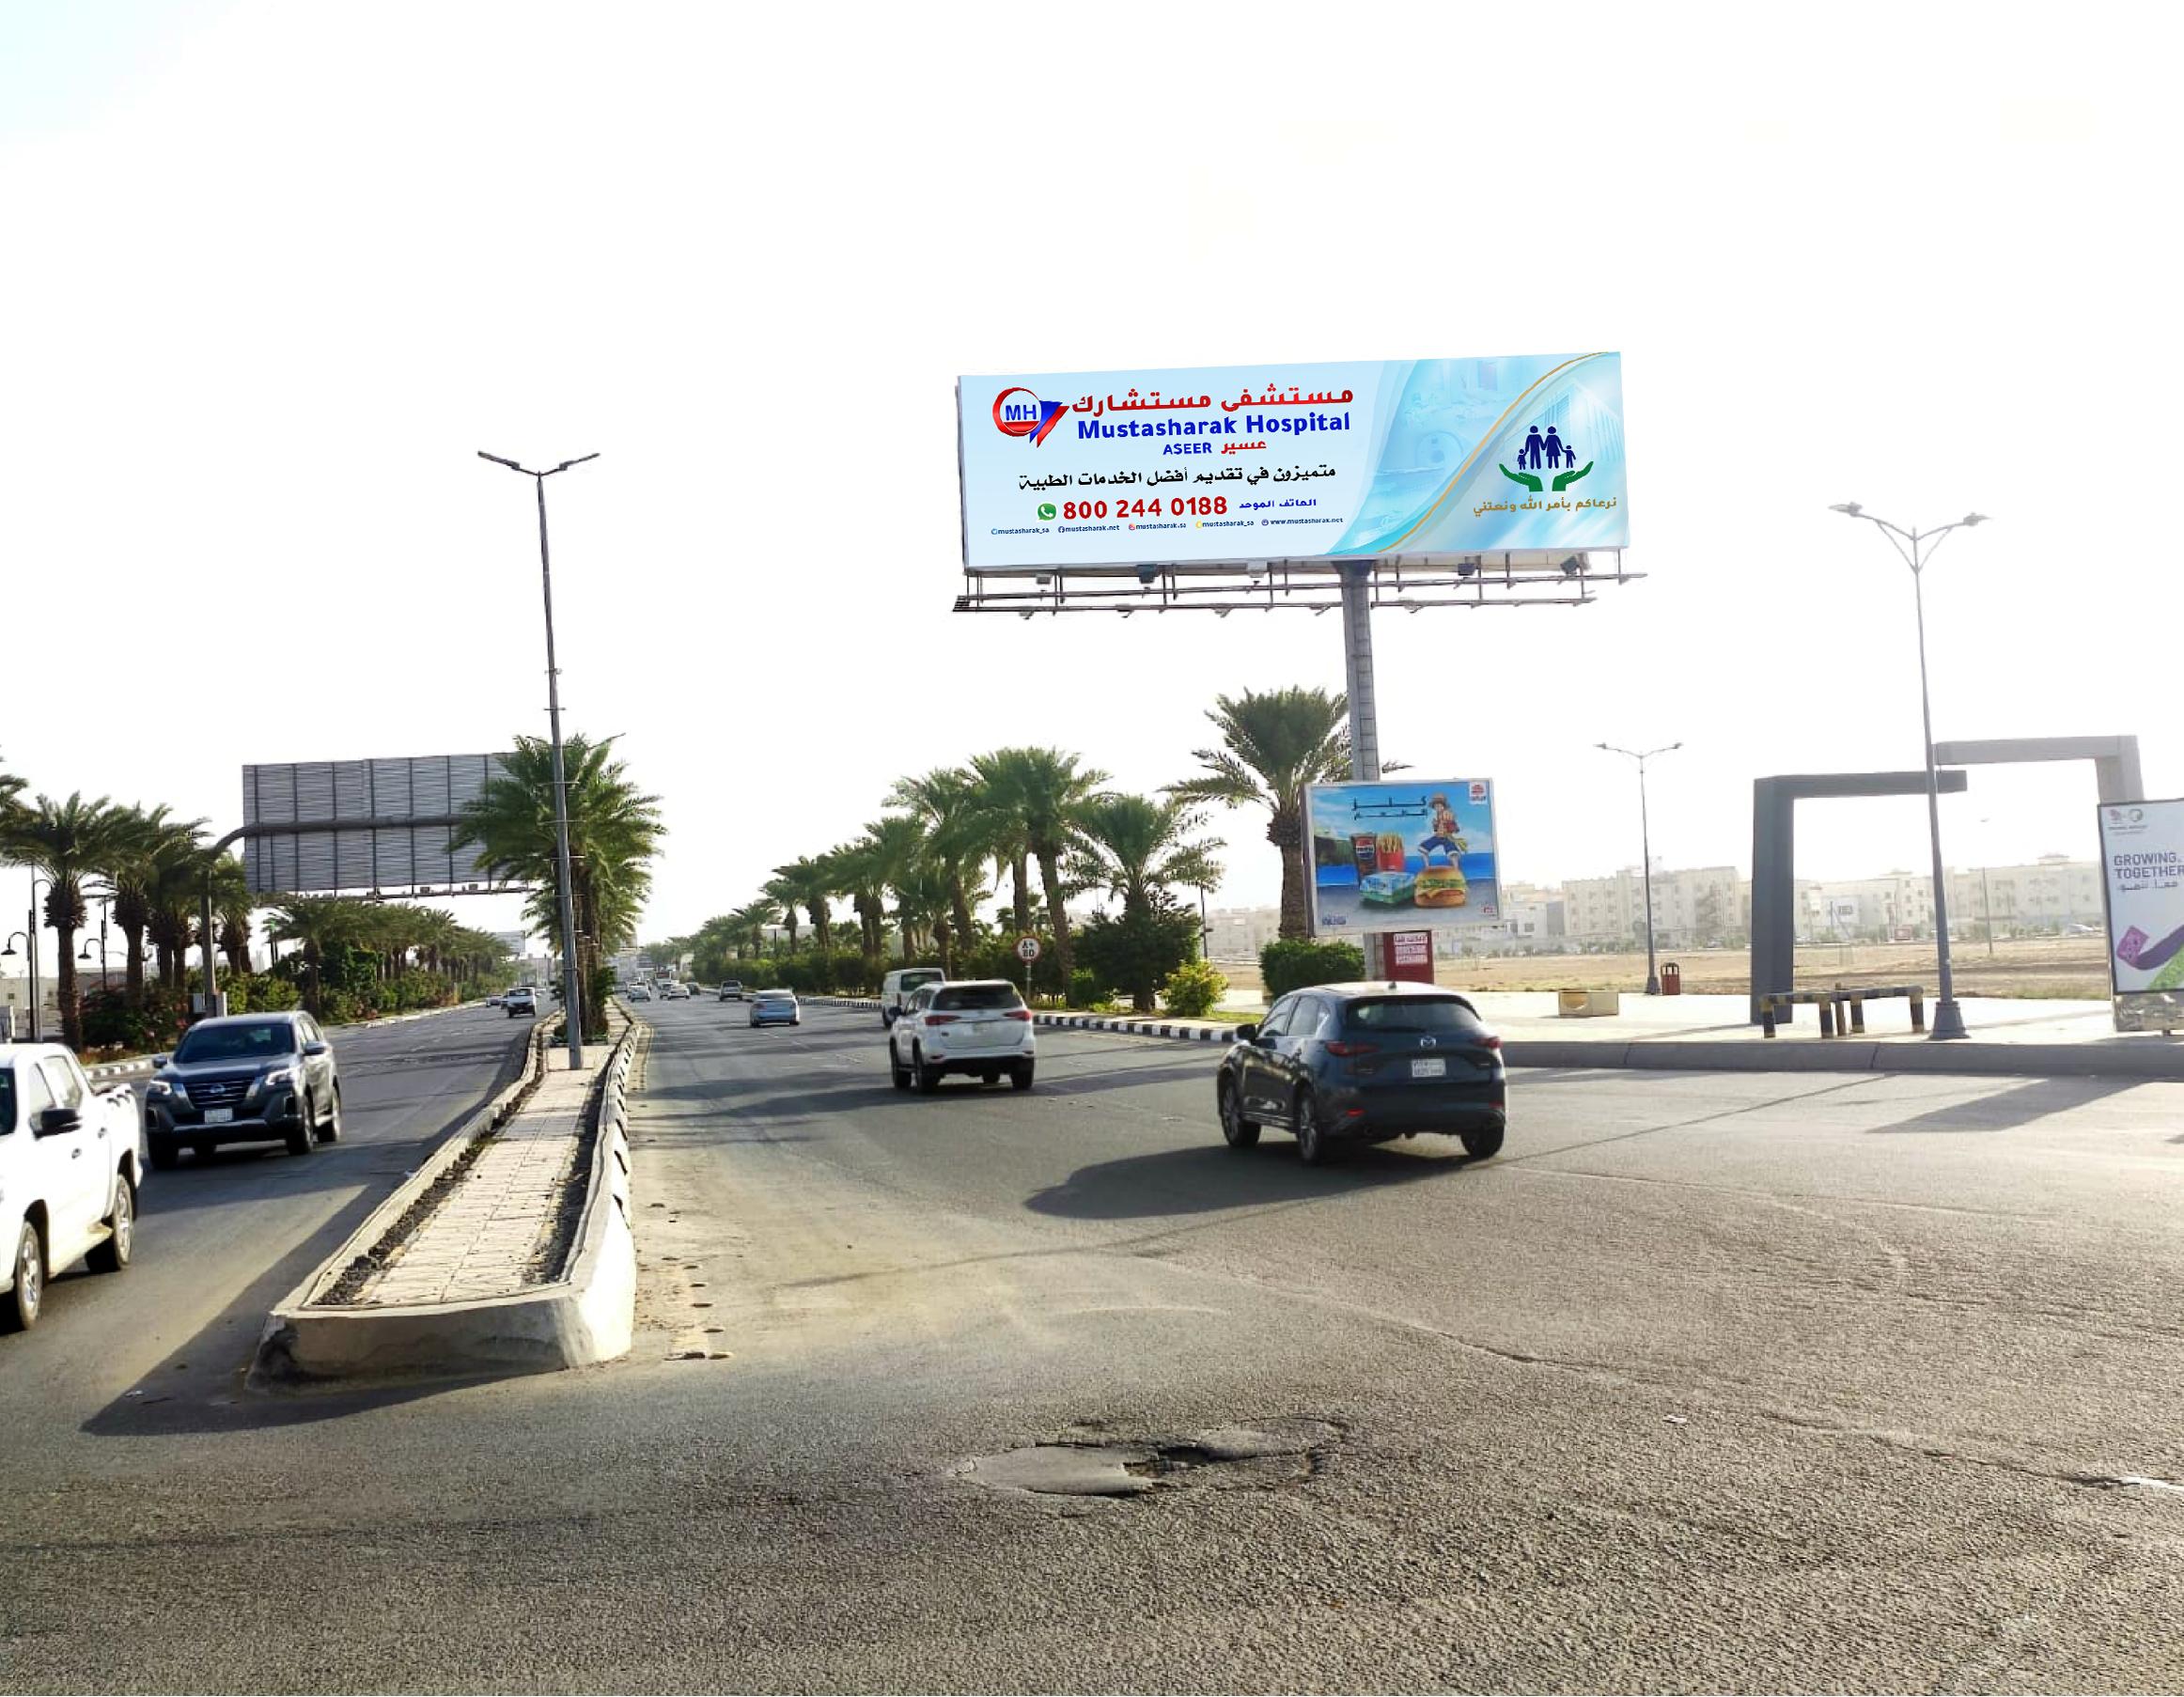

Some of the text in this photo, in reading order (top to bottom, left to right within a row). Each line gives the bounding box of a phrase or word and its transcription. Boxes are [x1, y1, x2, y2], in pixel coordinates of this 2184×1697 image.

[1071, 382, 1354, 417] مستشفى مستشارك
[1005, 404, 1037, 421] MH
[1078, 411, 1350, 440] Mustasharak Hospital
[1162, 442, 1212, 456] ASEER
[1221, 440, 1267, 455] عسير
[1019, 464, 1336, 490] متميزون في تقديم أفضل الخدمات الطبية
[1063, 496, 1227, 521] 800 244 0188
[1239, 498, 1317, 510] الهاتف الموحد
[1473, 494, 1617, 517] نرعاكم بأمر الله ونعتني
[2114, 851, 2176, 866] GROWING
